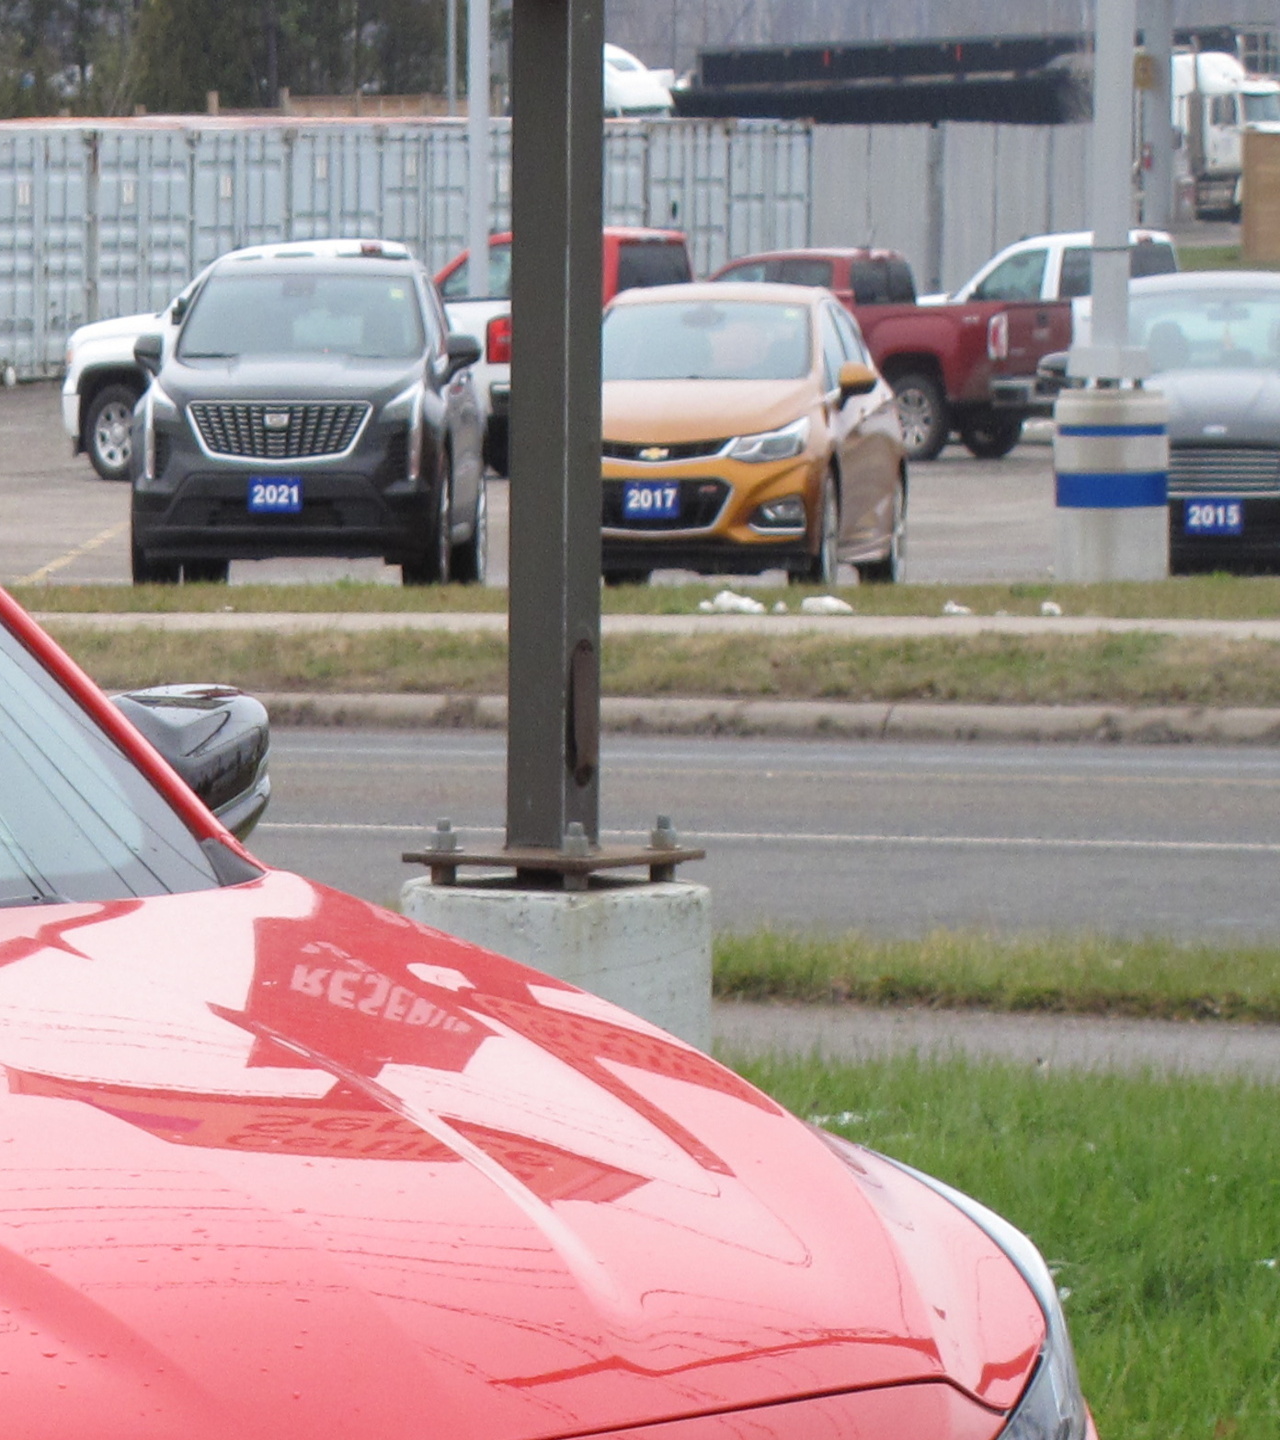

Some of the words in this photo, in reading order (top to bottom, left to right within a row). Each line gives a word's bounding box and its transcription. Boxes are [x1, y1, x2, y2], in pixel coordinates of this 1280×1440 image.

[252, 484, 299, 504] 2021
[627, 488, 677, 509] 2017
[1188, 504, 1240, 526] 2015
